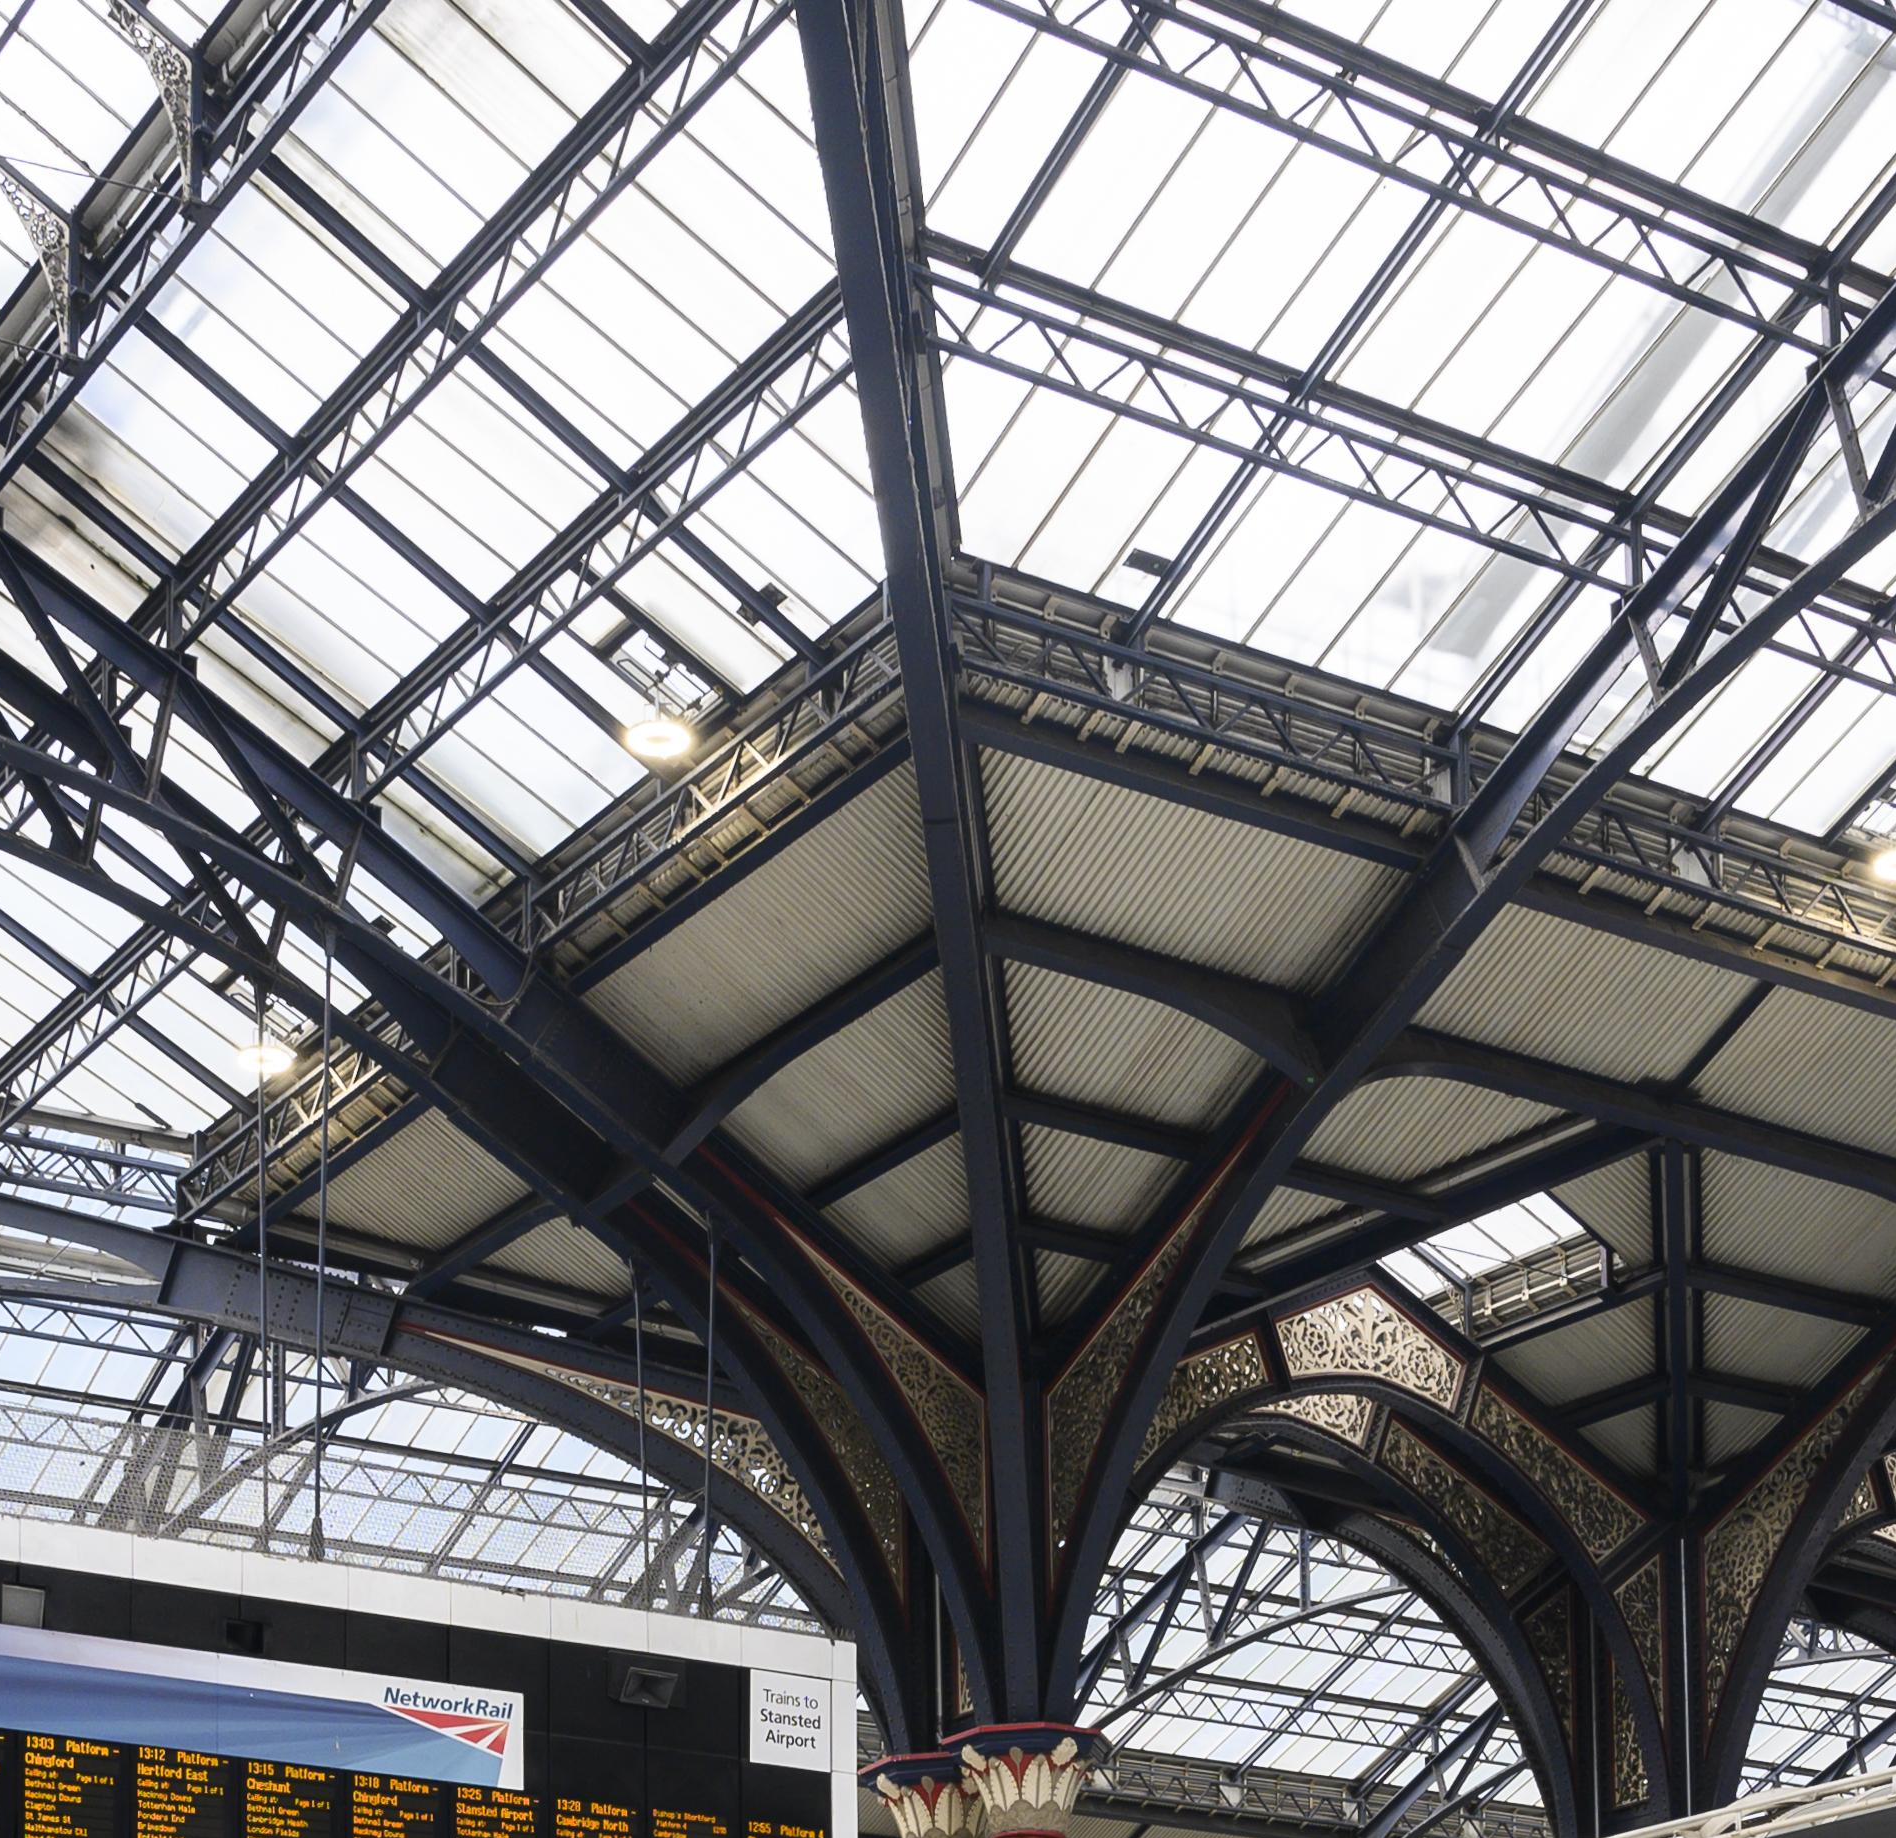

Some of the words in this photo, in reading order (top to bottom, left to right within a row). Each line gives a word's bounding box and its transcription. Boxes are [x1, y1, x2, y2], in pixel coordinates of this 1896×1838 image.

[385, 1686, 513, 1720] NetworkRail
[763, 1689, 800, 1707] Trains
[804, 1696, 818, 1709] to
[761, 1709, 820, 1729] Stansted
[766, 1730, 815, 1749] Airport
[247, 1778, 290, 1793] Cheshunt
